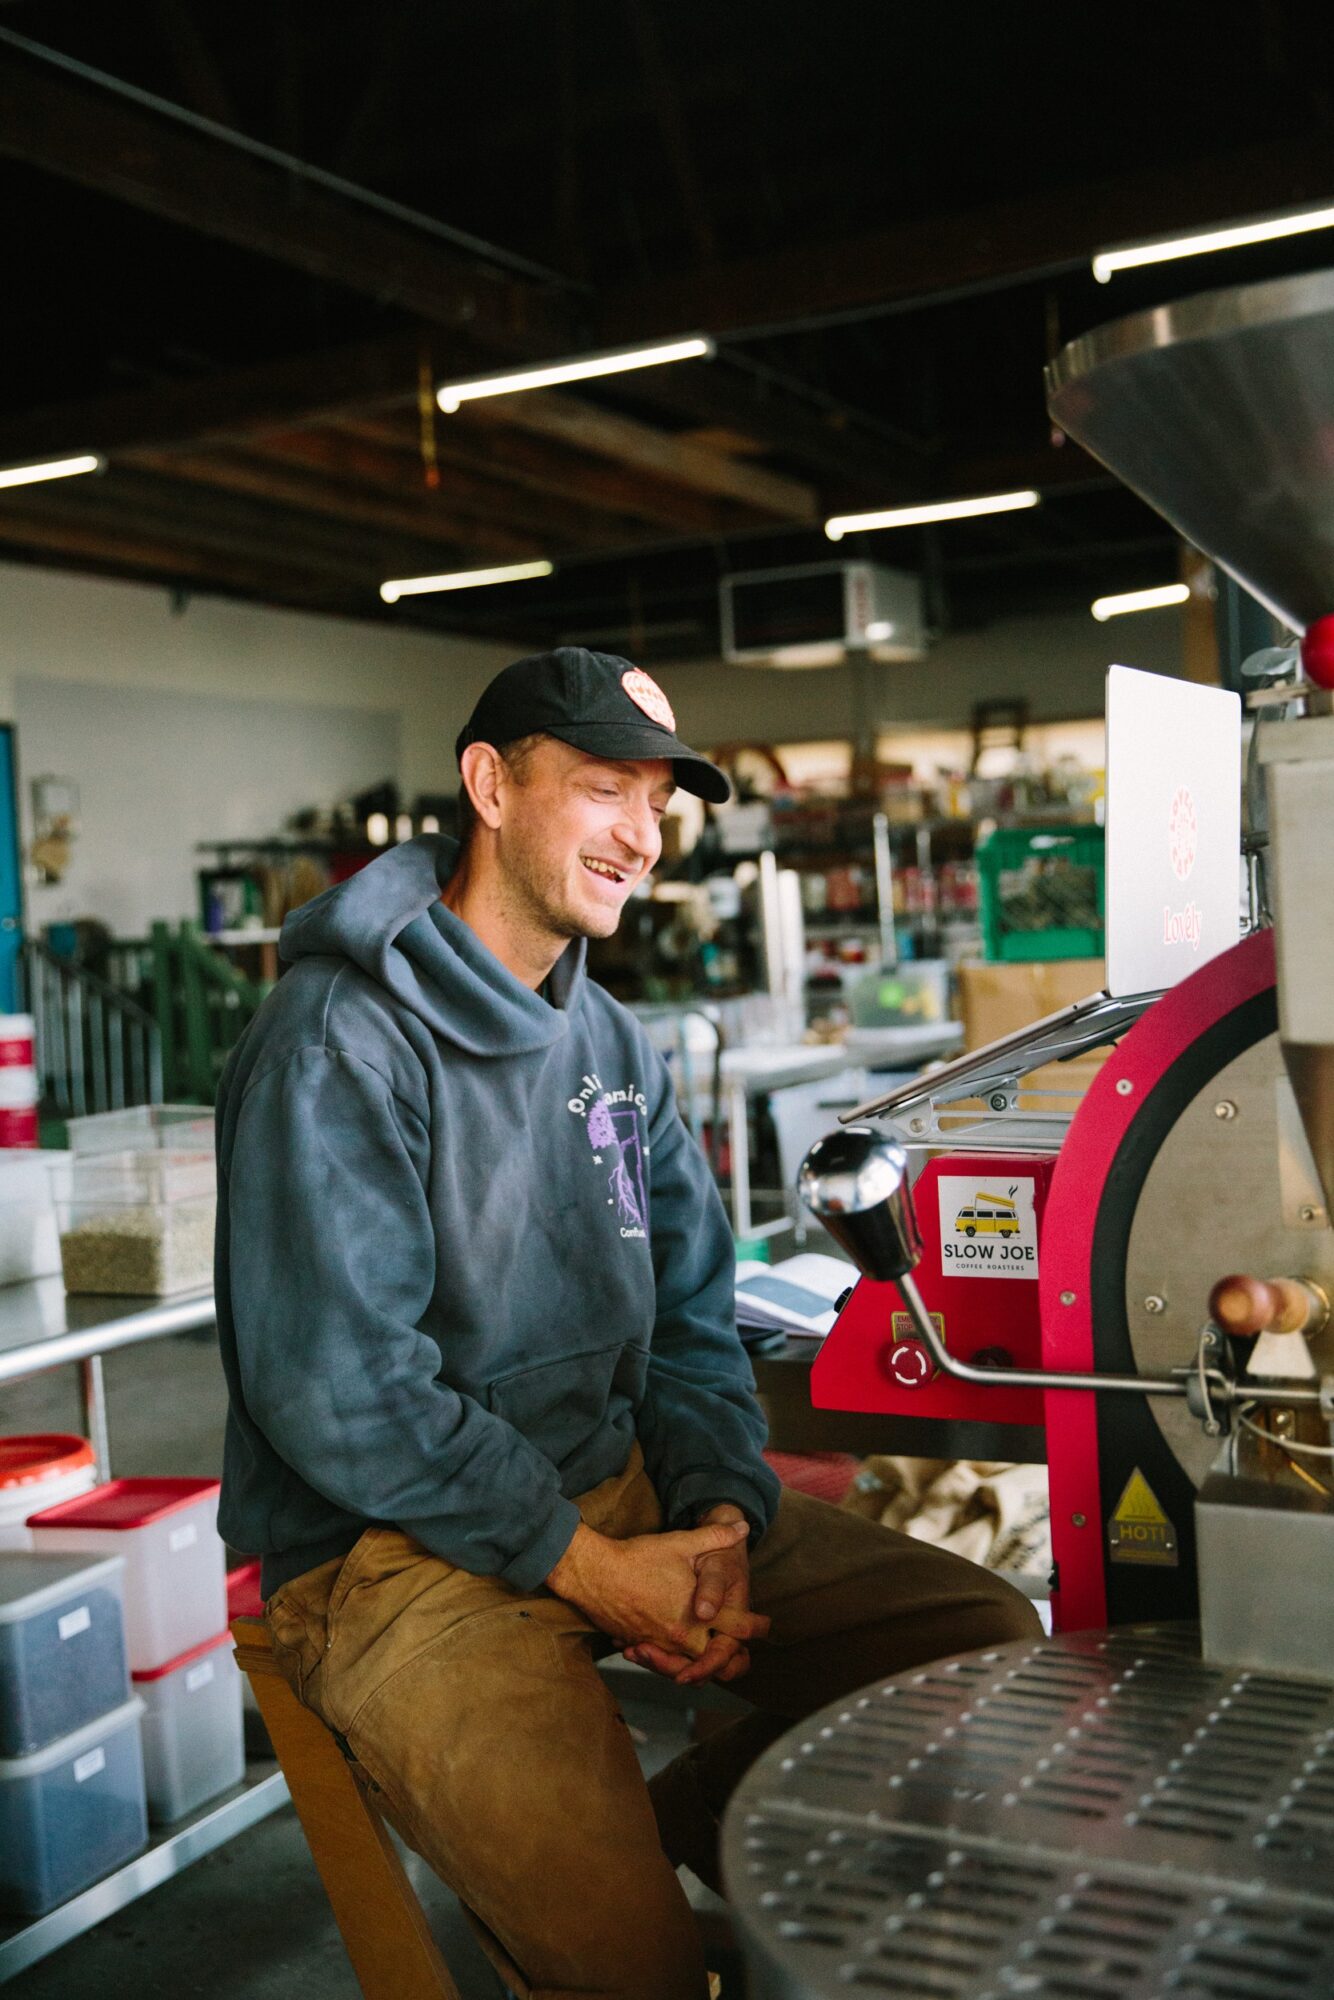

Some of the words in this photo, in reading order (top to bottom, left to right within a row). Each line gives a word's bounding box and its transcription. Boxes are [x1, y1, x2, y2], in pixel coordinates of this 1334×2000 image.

[567, 1074, 602, 1113] Onli
[944, 1244, 994, 1259] SLOW
[1000, 1246, 1034, 1260] JOE
